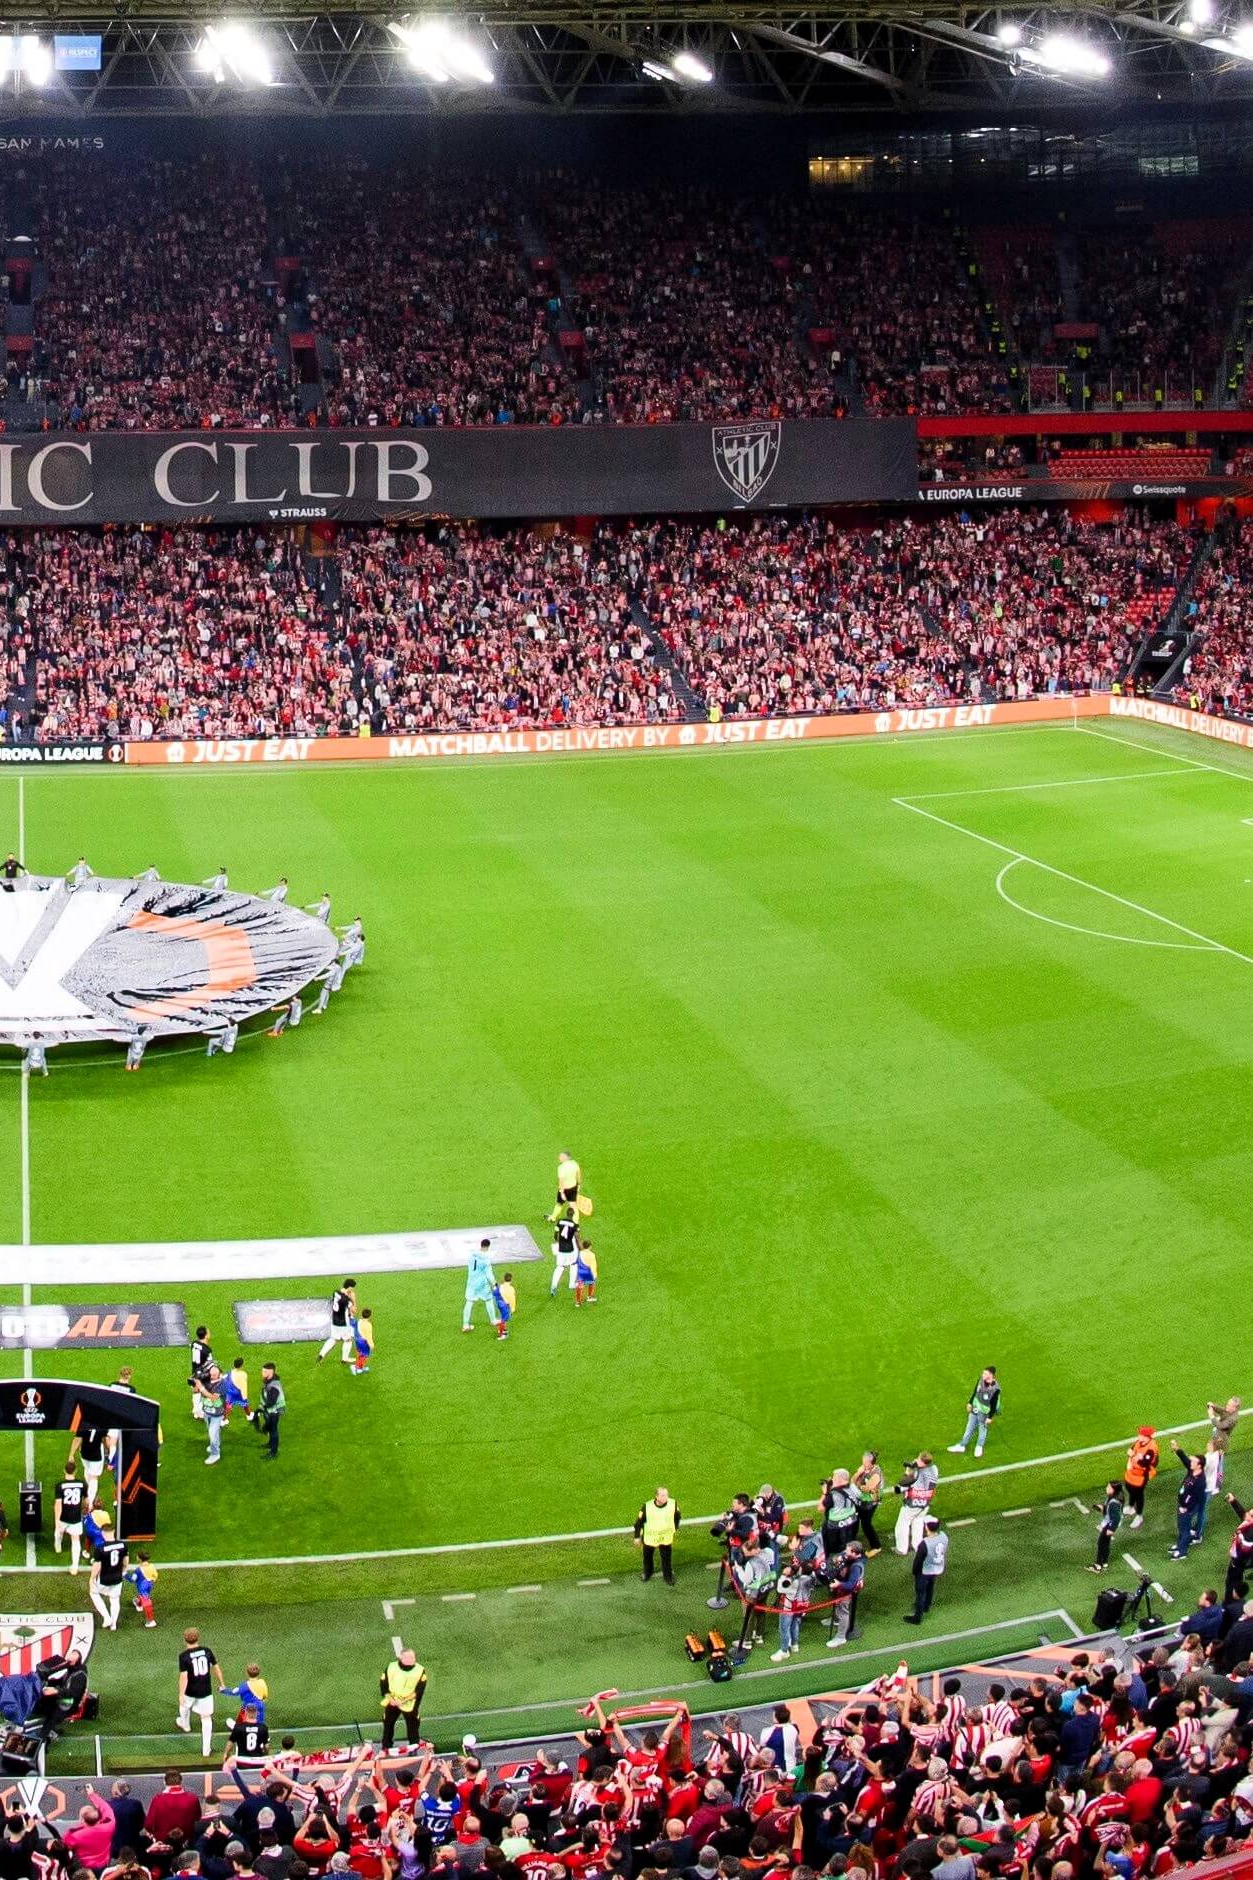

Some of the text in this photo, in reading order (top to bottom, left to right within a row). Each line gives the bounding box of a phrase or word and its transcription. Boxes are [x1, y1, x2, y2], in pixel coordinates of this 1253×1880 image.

[153, 441, 433, 507] CLUB
[927, 488, 973, 500] EUROPA
[976, 487, 1022, 498] LEAGUE
[281, 507, 326, 518] STRAUSS
[898, 704, 996, 730] JUST EAT
[1110, 698, 1189, 731] MATCHBALL
[1192, 713, 1244, 745] DELIVERY
[389, 717, 811, 757] MATCHBALL DELIVERY BY JUST EAT
[45, 746, 104, 761] LEAGUE
[193, 738, 316, 763] JUST EAT
[191, 1656, 209, 1677] 10
[427, 1817, 449, 1832] 10
